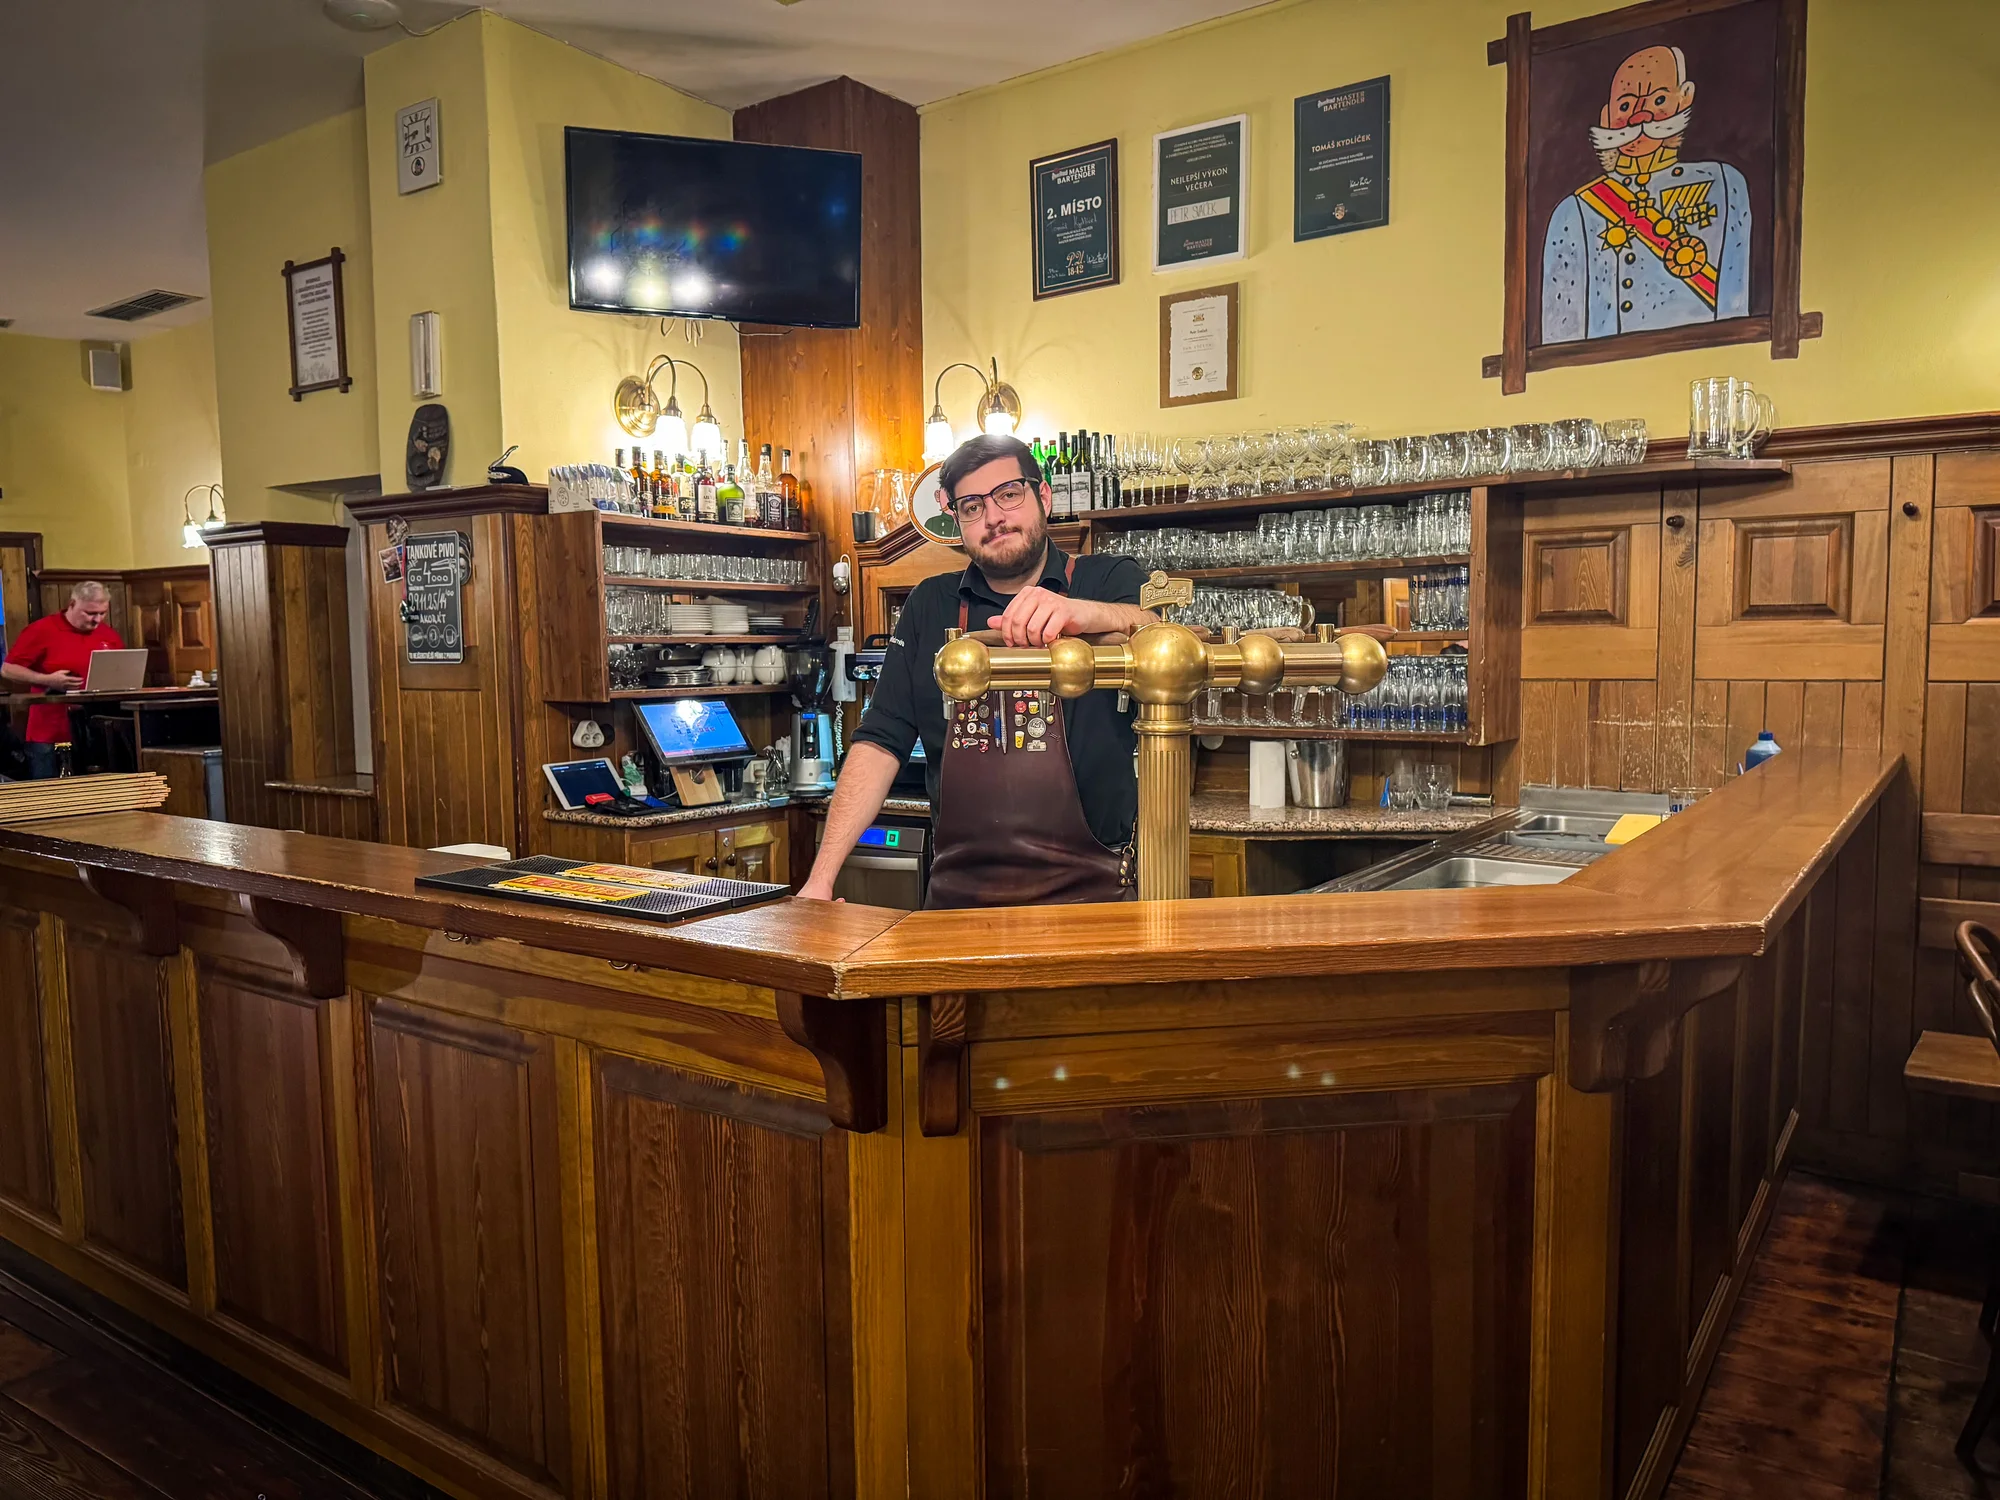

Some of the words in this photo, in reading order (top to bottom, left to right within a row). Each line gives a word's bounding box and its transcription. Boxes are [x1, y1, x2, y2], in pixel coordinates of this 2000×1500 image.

[1337, 91, 1364, 102] MASTER
[1324, 98, 1365, 112] BARTENDER
[1312, 140, 1335, 152] TOMÁŠ
[1336, 134, 1371, 147] KYDLÍČEK
[1057, 170, 1096, 184] BARTENDER
[1069, 164, 1096, 175] MASTER
[1170, 172, 1200, 185] NEJLEPŠÍ
[1202, 167, 1228, 179] VÝKON
[1185, 180, 1213, 191] VEČERA
[1047, 208, 1057, 220] 2.
[1060, 196, 1102, 216] MÍSTO
[1170, 206, 1188, 223] PETR
[406, 540, 437, 560] TANKOVÉ
[439, 542, 454, 558] PIVO
